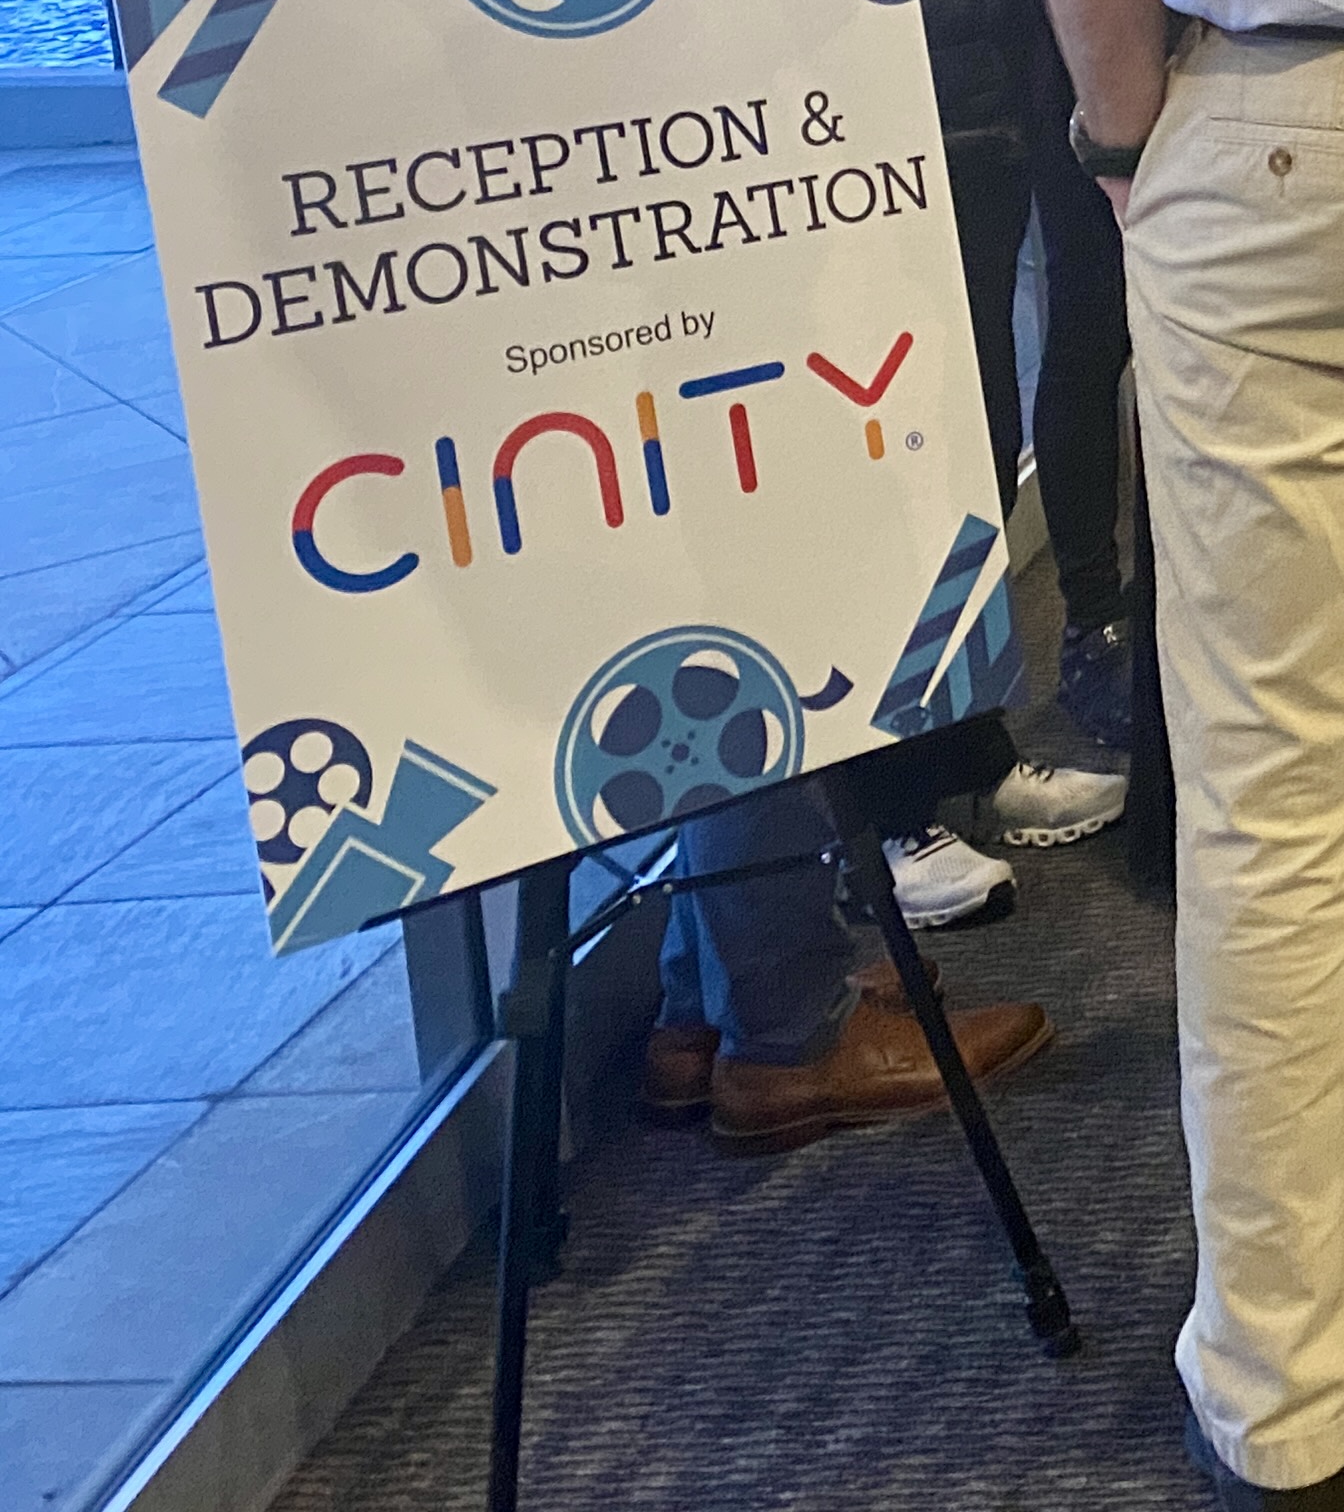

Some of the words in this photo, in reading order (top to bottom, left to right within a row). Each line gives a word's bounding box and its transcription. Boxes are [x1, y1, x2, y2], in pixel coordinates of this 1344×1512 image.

[283, 98, 770, 237] RECEPTION
[800, 89, 847, 147] &
[195, 155, 930, 350] DEMONSTRATION
[505, 315, 673, 376] Sponsored
[680, 308, 716, 341] by
